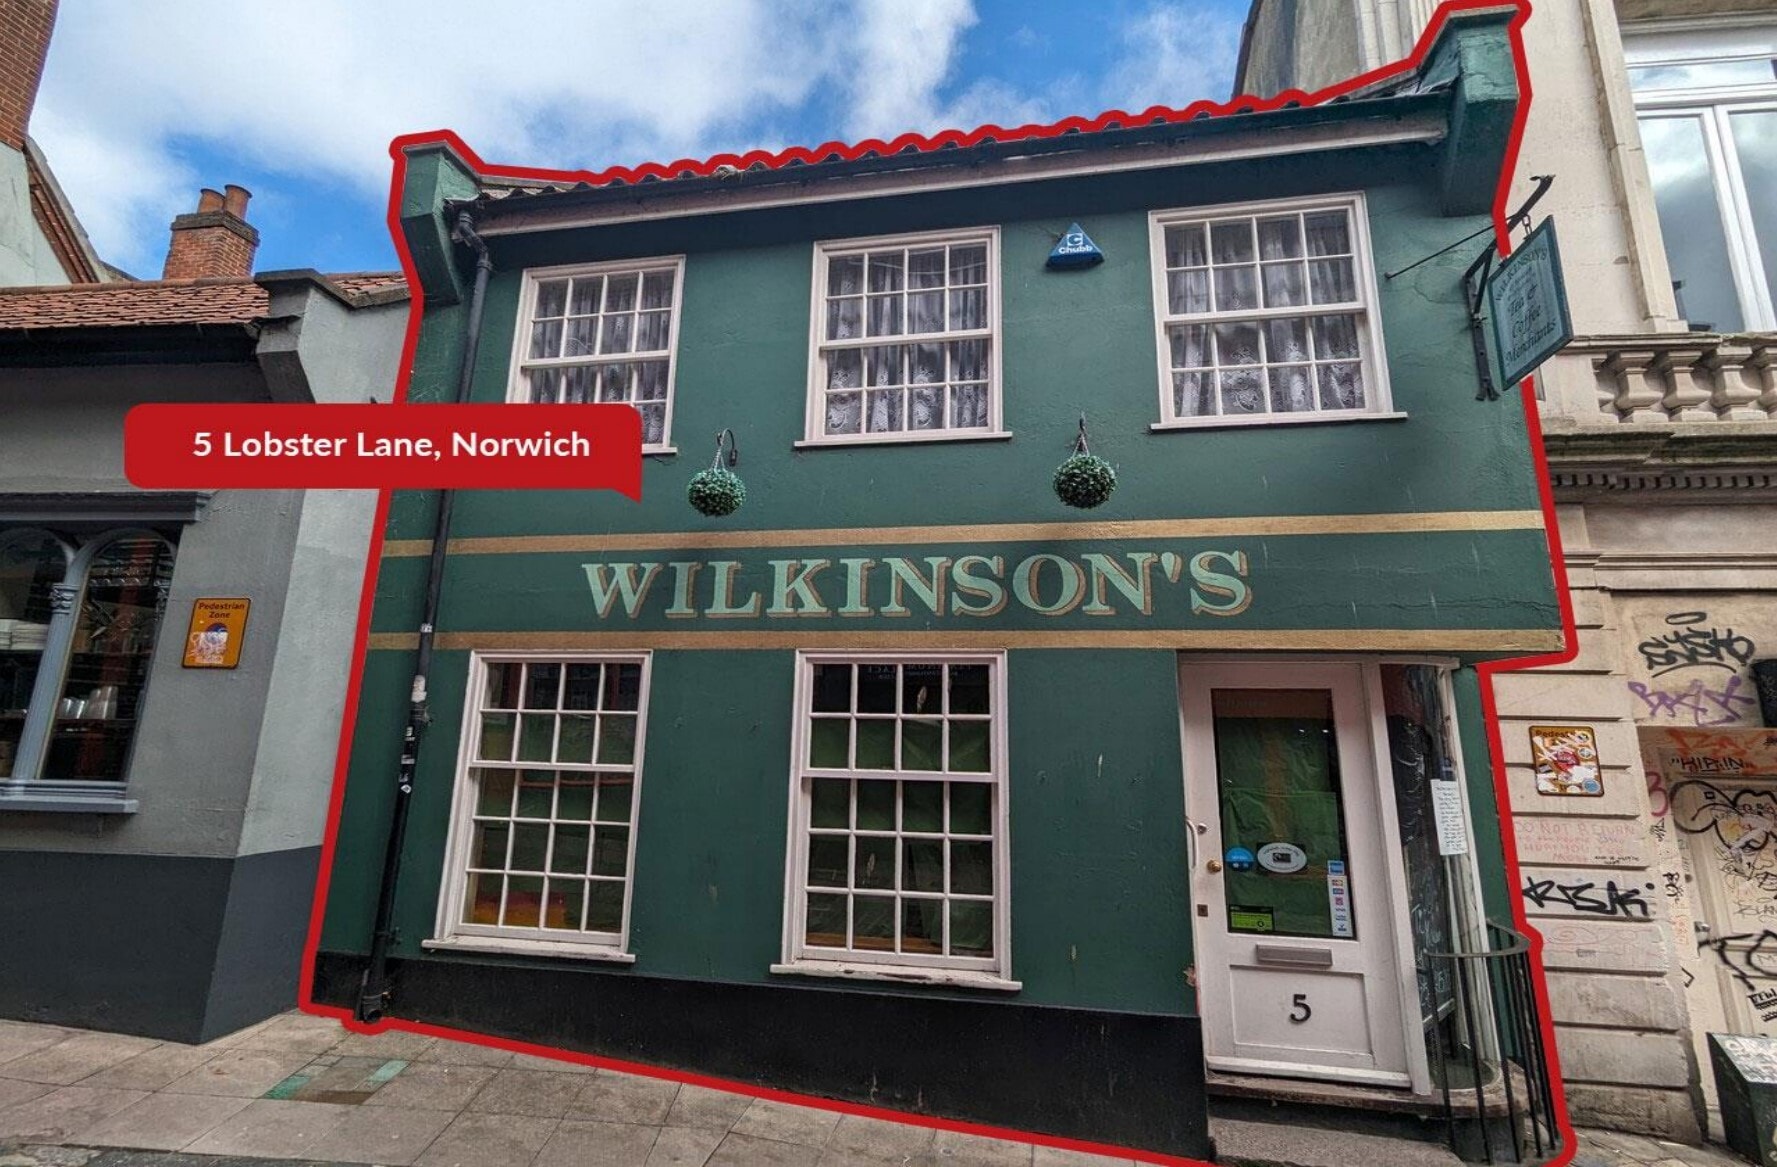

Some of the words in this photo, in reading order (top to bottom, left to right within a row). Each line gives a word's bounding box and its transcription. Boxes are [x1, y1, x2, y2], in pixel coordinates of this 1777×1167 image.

[1058, 245, 1093, 254] Chubb
[581, 550, 1252, 619] WILKINSON'S
[199, 602, 245, 610] Pedestrian
[1290, 994, 1311, 1022] 5
